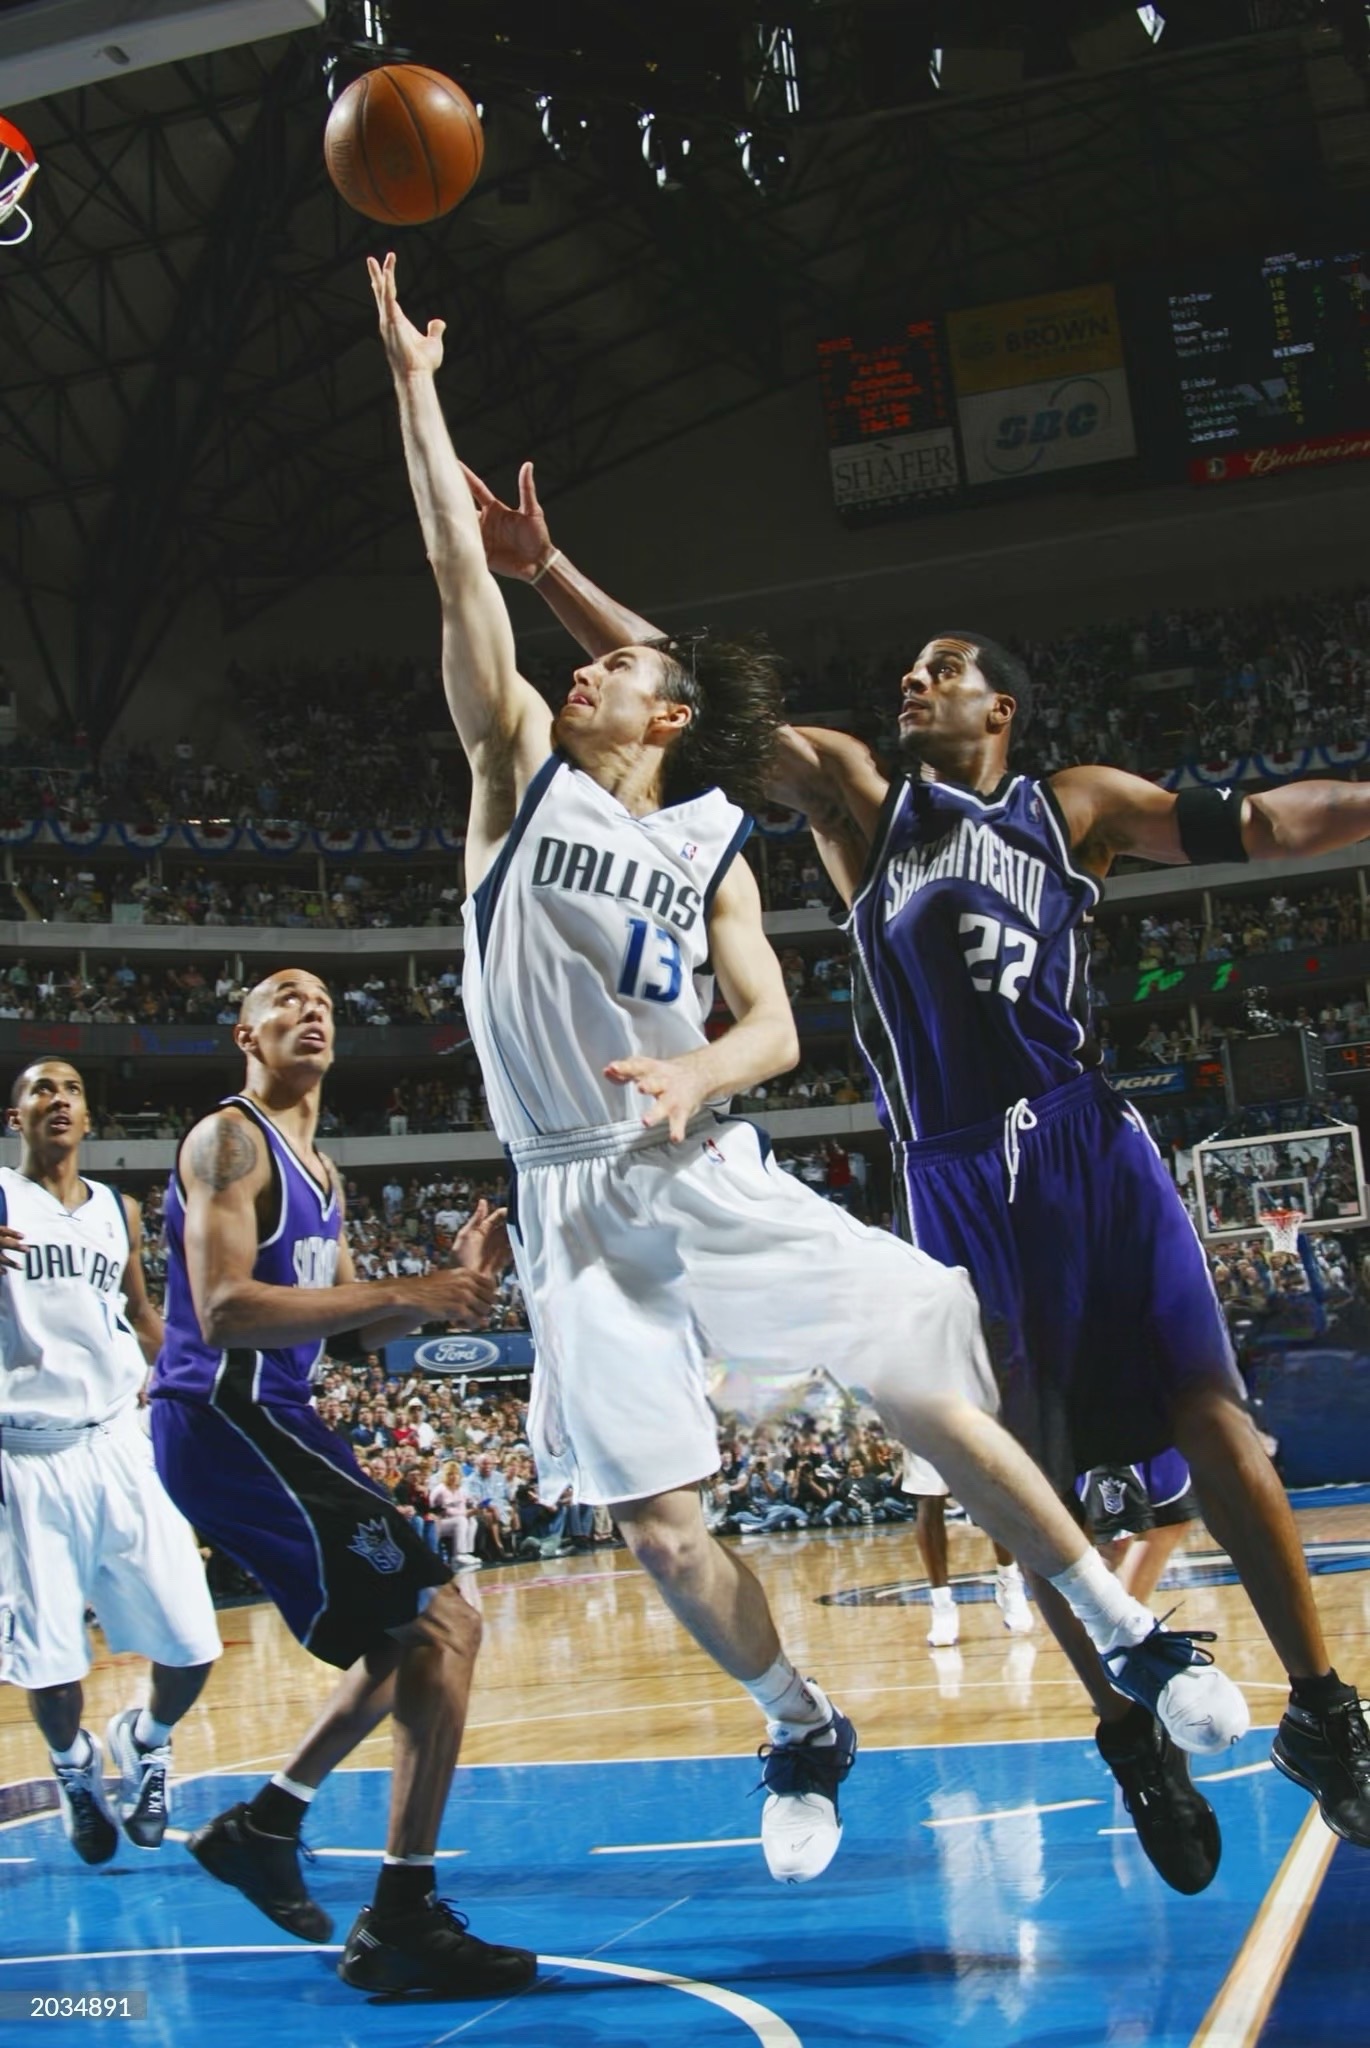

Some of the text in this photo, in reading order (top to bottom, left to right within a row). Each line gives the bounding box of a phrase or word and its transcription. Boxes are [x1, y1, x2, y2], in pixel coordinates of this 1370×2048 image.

[1006, 314, 1111, 353] BROWN
[835, 445, 956, 492] SHAFER
[531, 836, 702, 932] DALLAS
[617, 917, 683, 1006] 13
[958, 912, 1039, 1004] 22
[1112, 1072, 1178, 1092] IGHT
[434, 1343, 478, 1362] Ford
